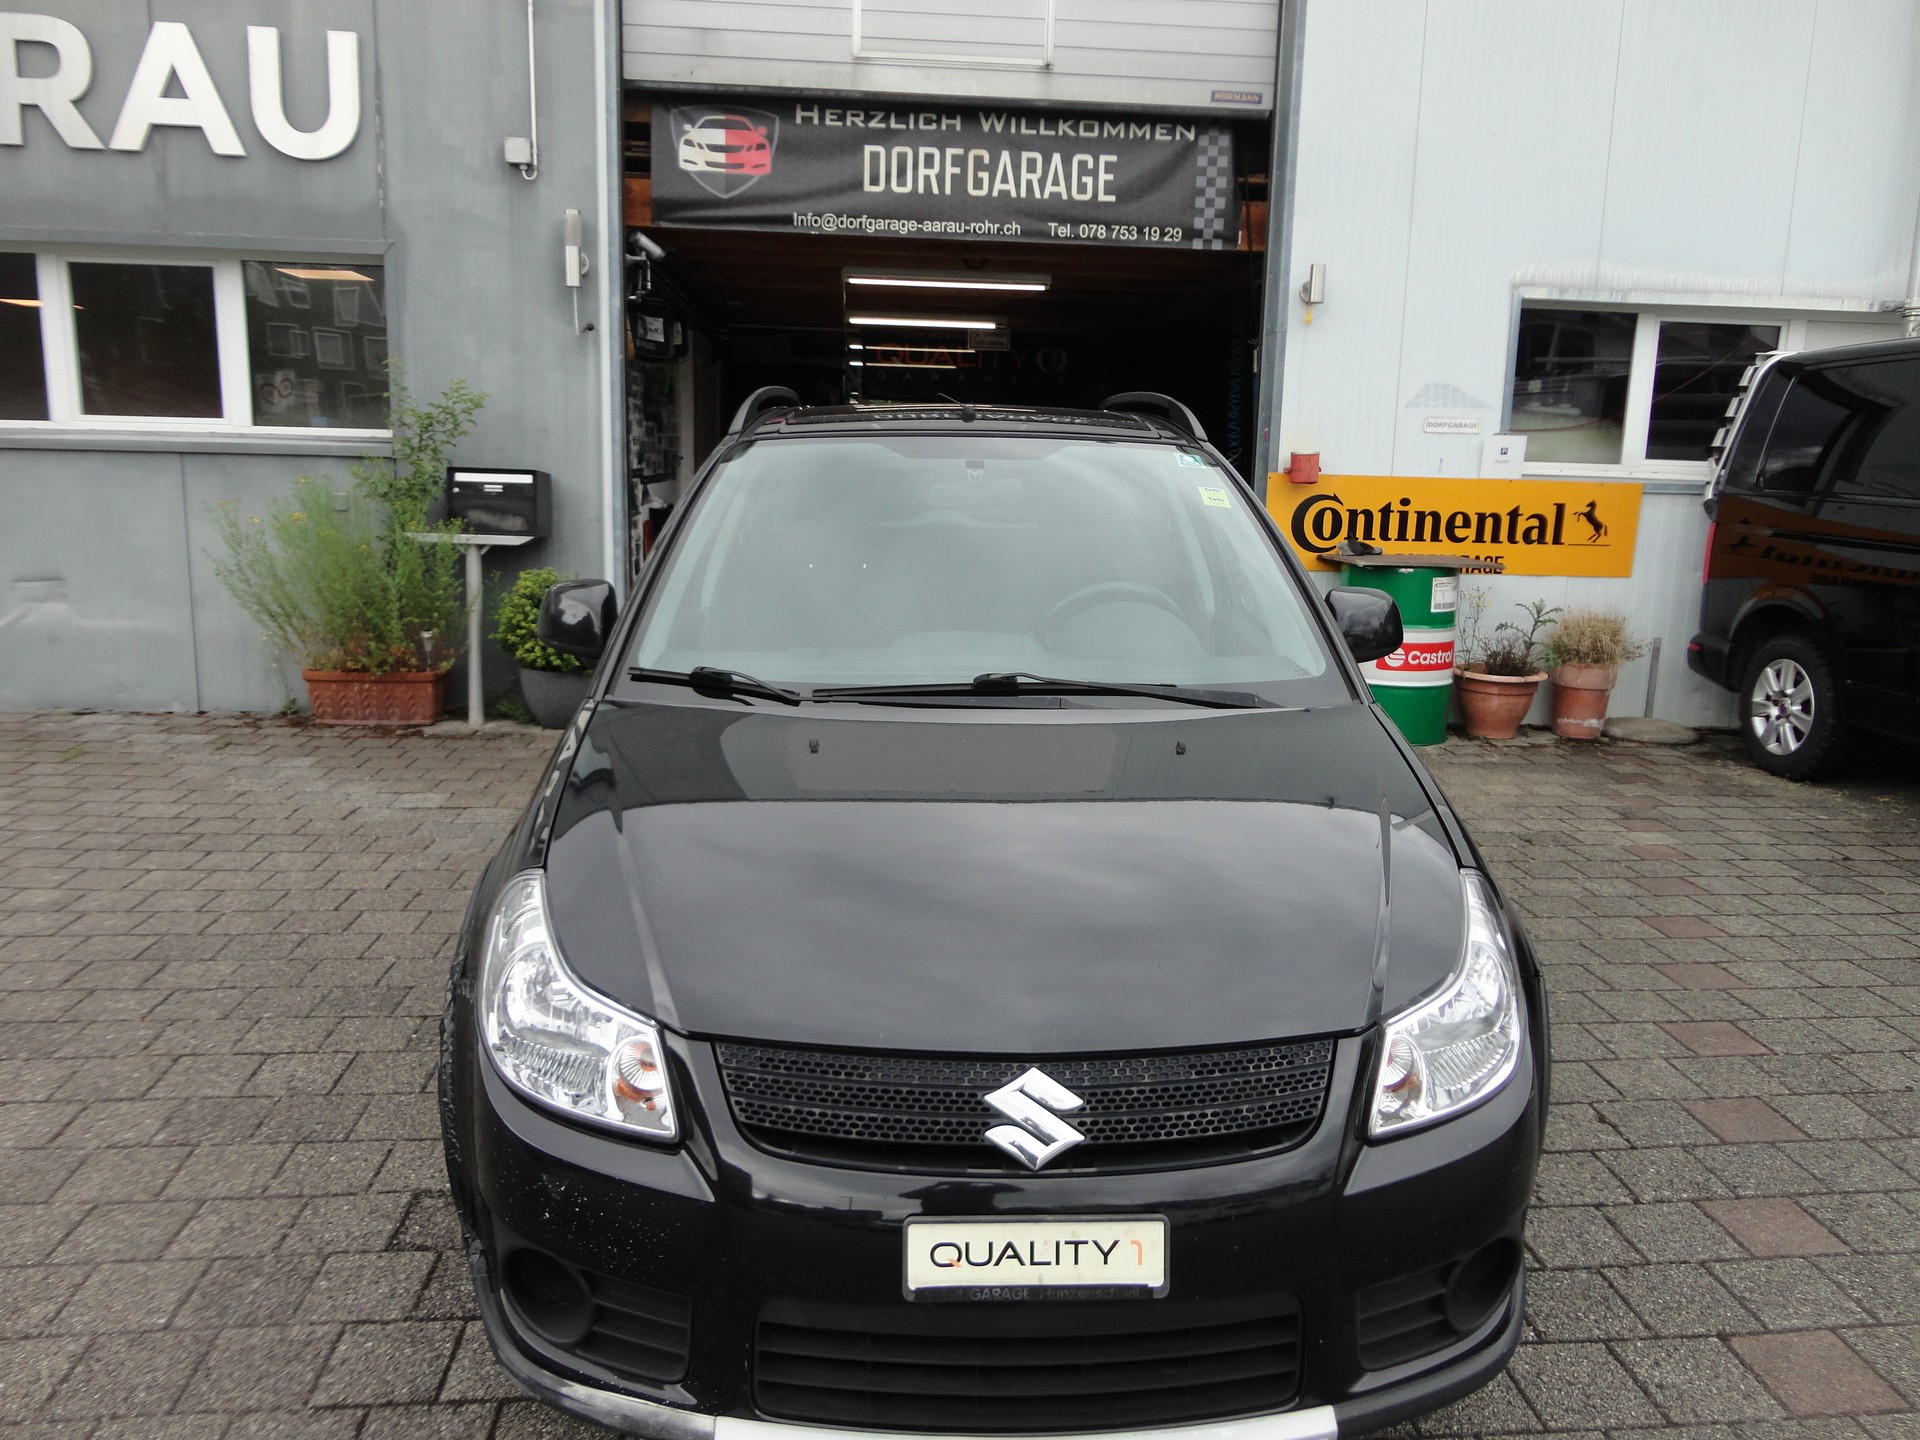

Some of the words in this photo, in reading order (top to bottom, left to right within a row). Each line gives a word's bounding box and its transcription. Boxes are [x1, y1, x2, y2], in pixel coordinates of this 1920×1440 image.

[0, 11, 362, 161] RAU
[794, 103, 963, 132] HERZLICH
[978, 111, 1196, 143] WILLKOMMEN
[863, 144, 1118, 203] DORFGARAGE
[792, 211, 1022, 237] Info@dorfgarage-aarau-rohr.ch
[1048, 221, 1075, 238] Tel.
[1079, 224, 1106, 239] 078
[1111, 225, 1138, 240] 753
[1142, 226, 1160, 241] 19
[1163, 227, 1183, 242] 29
[875, 342, 1029, 370] QUALITY
[877, 370, 1066, 386] GARANTIE
[1427, 421, 1478, 429] DORFGARAGE
[1290, 492, 1567, 554] Continental
[1407, 647, 1454, 665] Castrol
[930, 1239, 1121, 1268] QUALITY
[969, 1286, 1031, 1301] GARAGE
